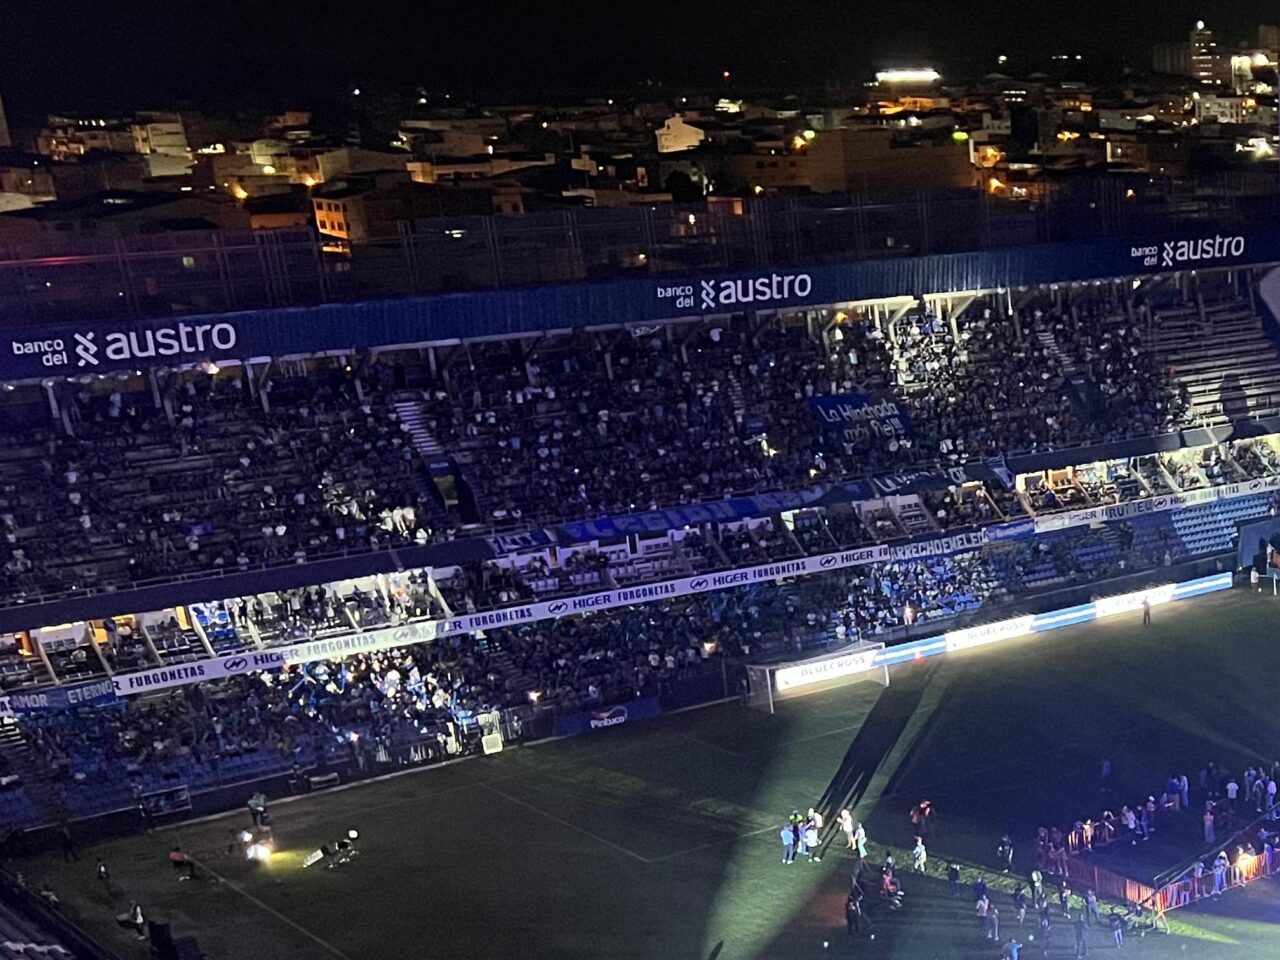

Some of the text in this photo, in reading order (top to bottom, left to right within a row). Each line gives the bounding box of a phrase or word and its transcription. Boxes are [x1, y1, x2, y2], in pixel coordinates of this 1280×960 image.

[1131, 247, 1158, 258] banco
[1175, 235, 1245, 262] austro
[1143, 255, 1158, 265] del
[657, 284, 694, 299] banco
[718, 273, 812, 304] austro
[676, 295, 694, 308] del
[12, 338, 65, 355] banco
[105, 321, 237, 361] austro
[42, 349, 68, 366] del
[469, 607, 533, 628] FURGONETAS
[572, 594, 612, 609] HIGER
[617, 584, 676, 602] FURGONETAS
[712, 571, 749, 586] HIGER
[752, 561, 807, 579] FURGONETAS
[840, 550, 874, 564] HIGER
[129, 665, 205, 689] FURGONETAS
[253, 649, 300, 666] HIGER
[306, 634, 377, 655] FURGONETAS
[800, 655, 866, 677] BLUECROSS
[13, 693, 48, 709] AMOR
[67, 680, 113, 703] ETERNO
[590, 716, 626, 730] Pintuco
